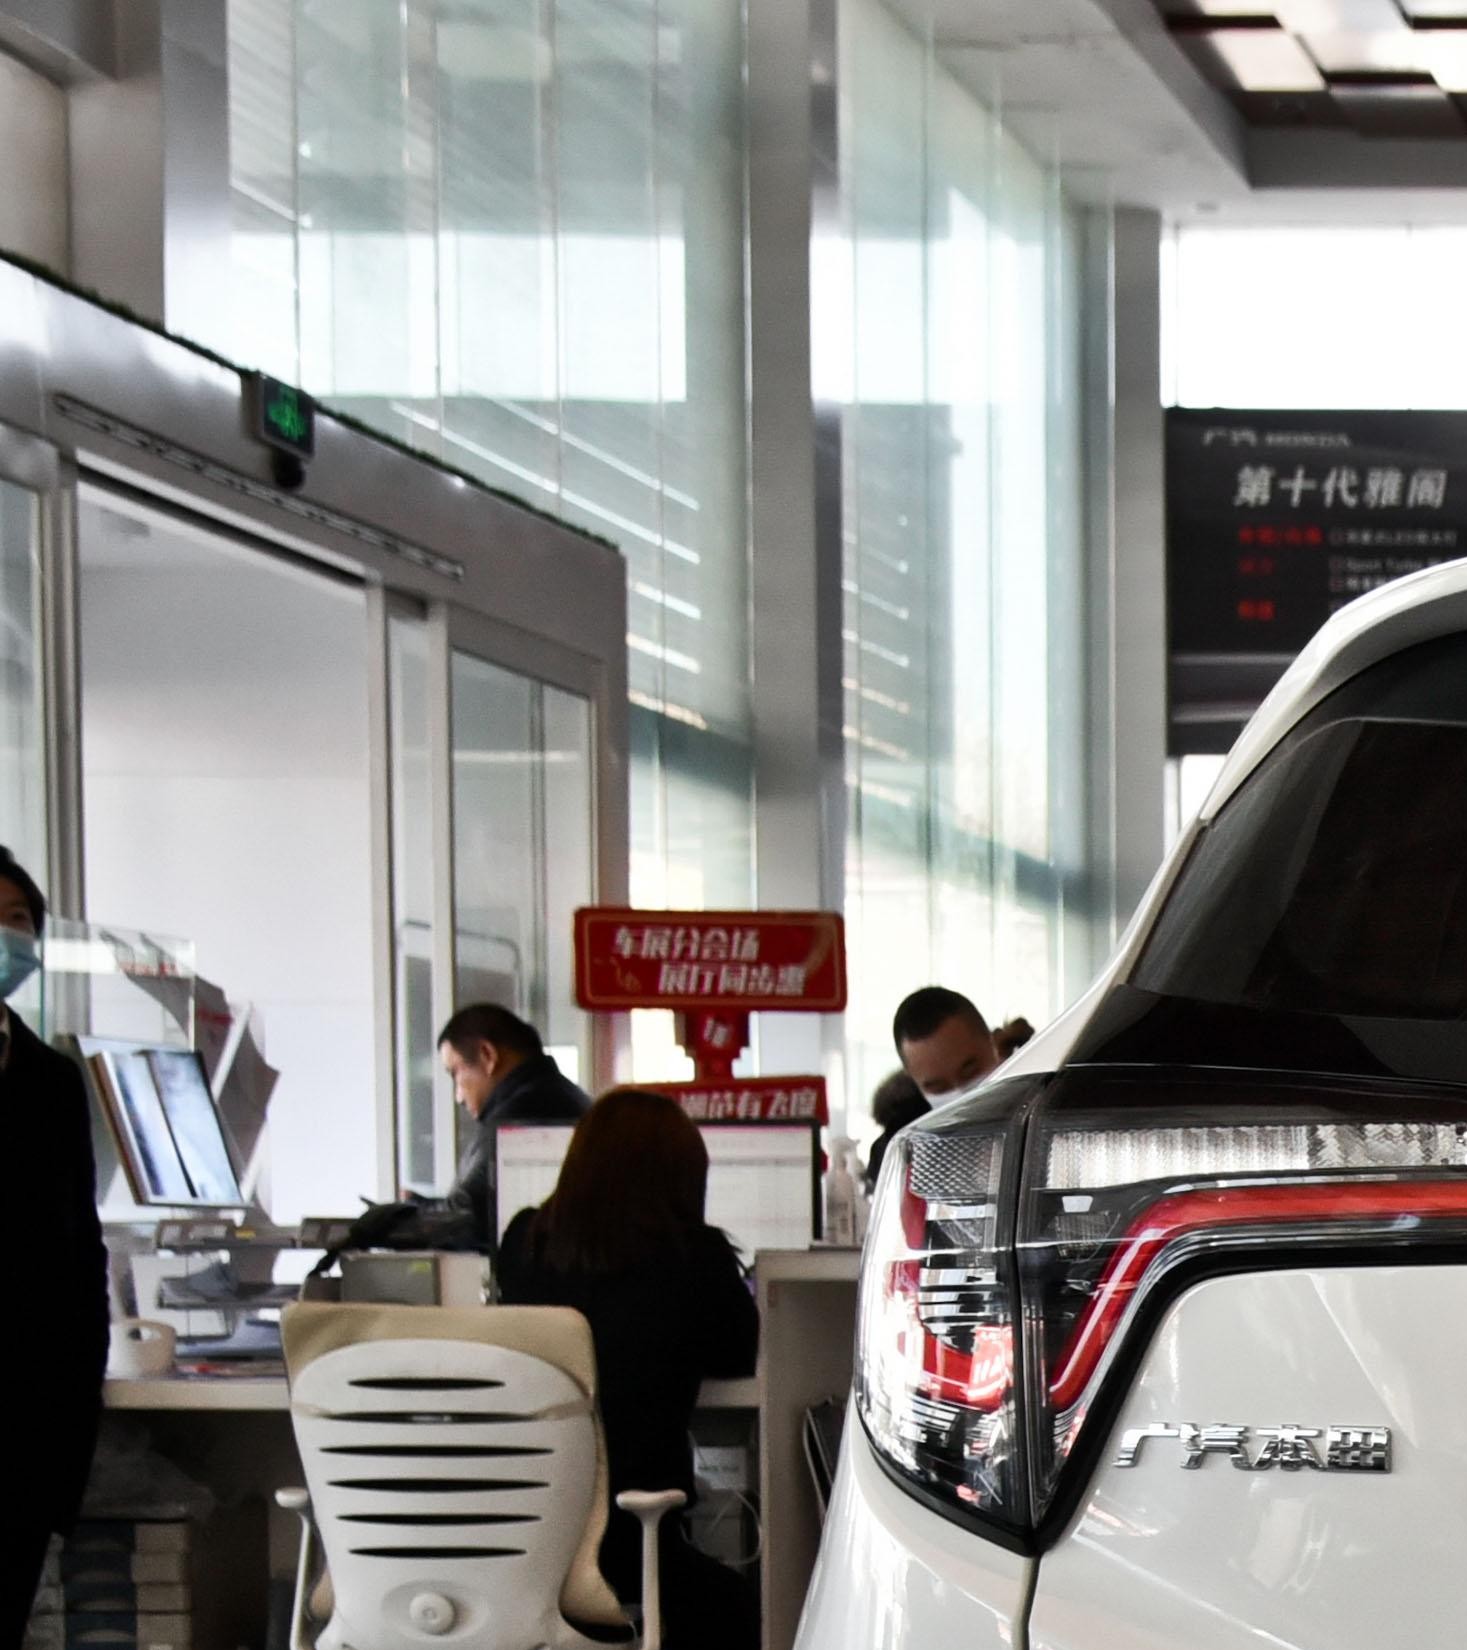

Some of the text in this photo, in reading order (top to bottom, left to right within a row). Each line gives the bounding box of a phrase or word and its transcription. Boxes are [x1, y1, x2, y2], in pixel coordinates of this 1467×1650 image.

[1234, 466, 1448, 508] 第十代雅阁
[1112, 1422, 1393, 1473] 广汽本田
